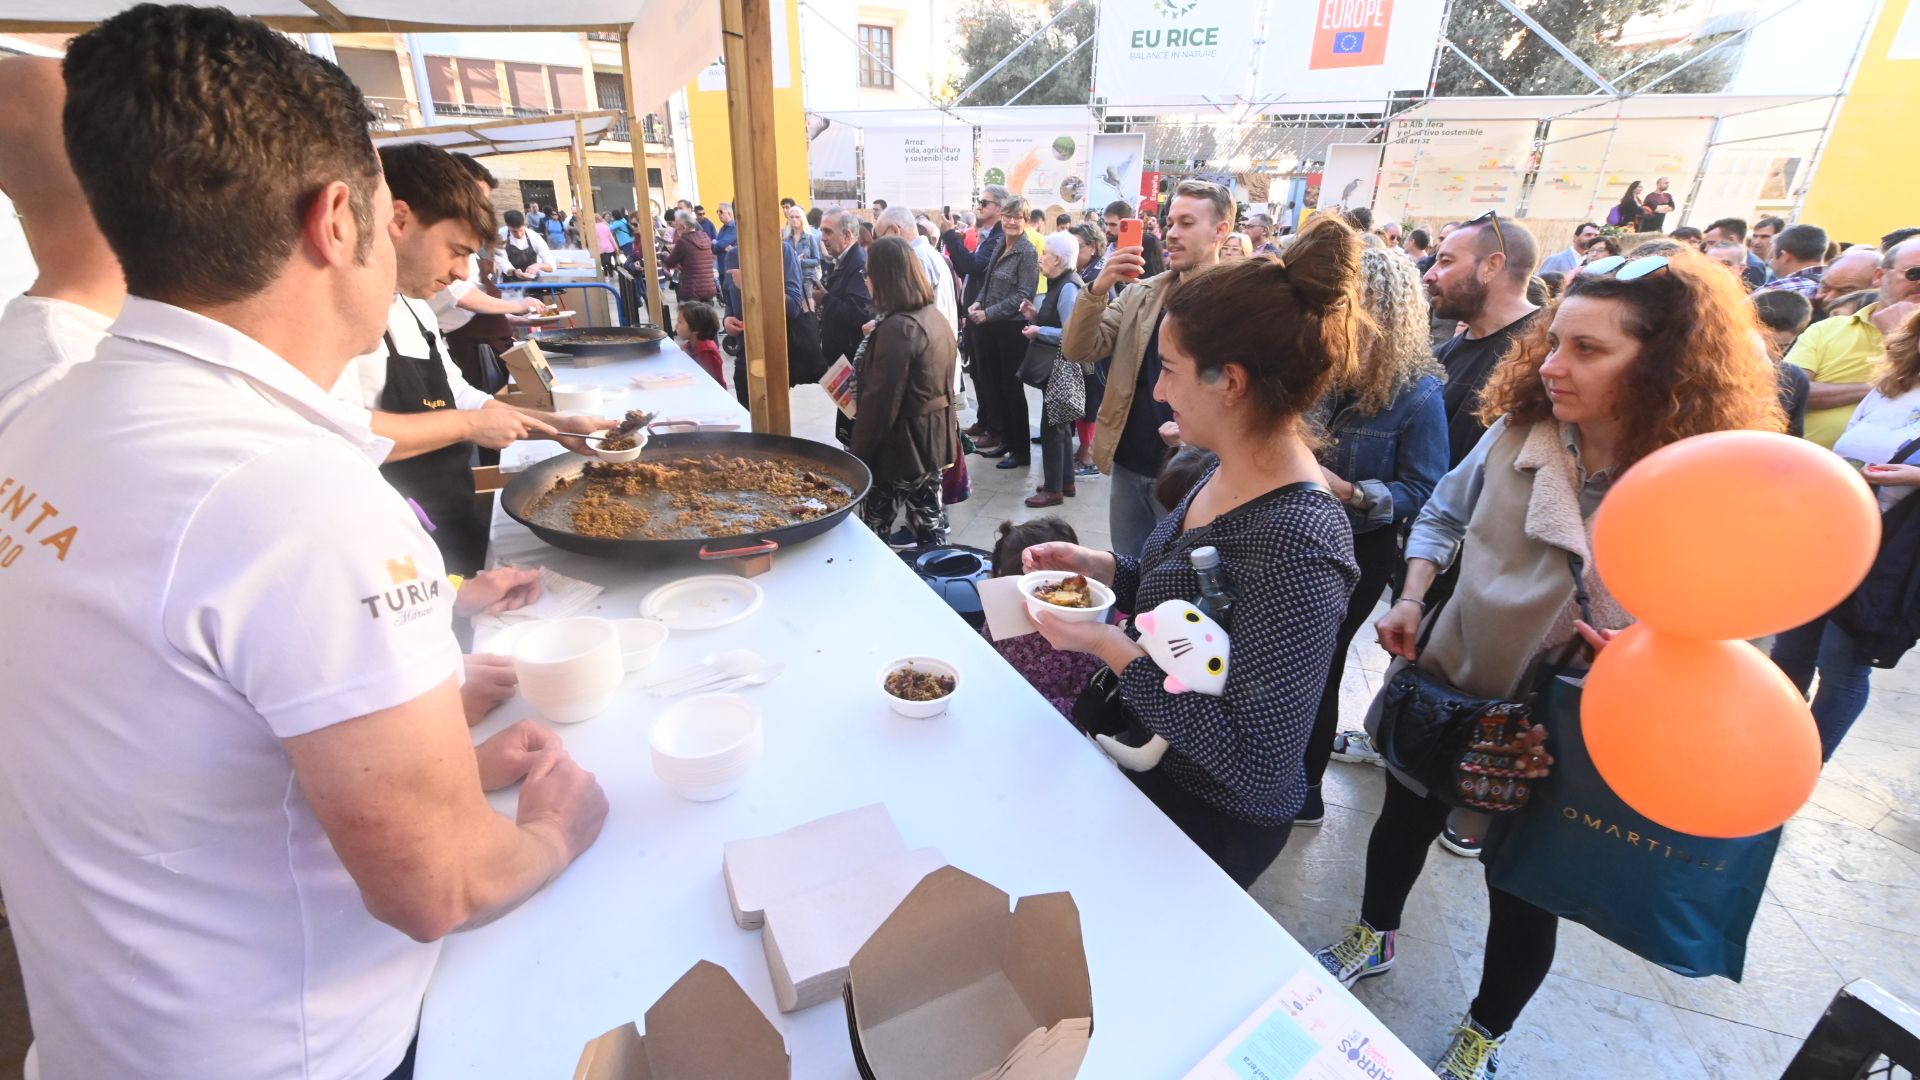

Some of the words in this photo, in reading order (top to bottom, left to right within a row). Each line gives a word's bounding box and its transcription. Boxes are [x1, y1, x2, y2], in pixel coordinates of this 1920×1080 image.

[1322, 0, 1384, 29] EUROPE
[1131, 30, 1161, 48] EU
[1166, 27, 1219, 47] RICE
[1129, 51, 1169, 61] BALANCE
[1171, 51, 1180, 59] IN
[1182, 49, 1217, 58] NATURE
[1441, 128, 1484, 136] sostenible
[904, 138, 926, 146] Arroz:
[361, 580, 439, 619] TURIA
